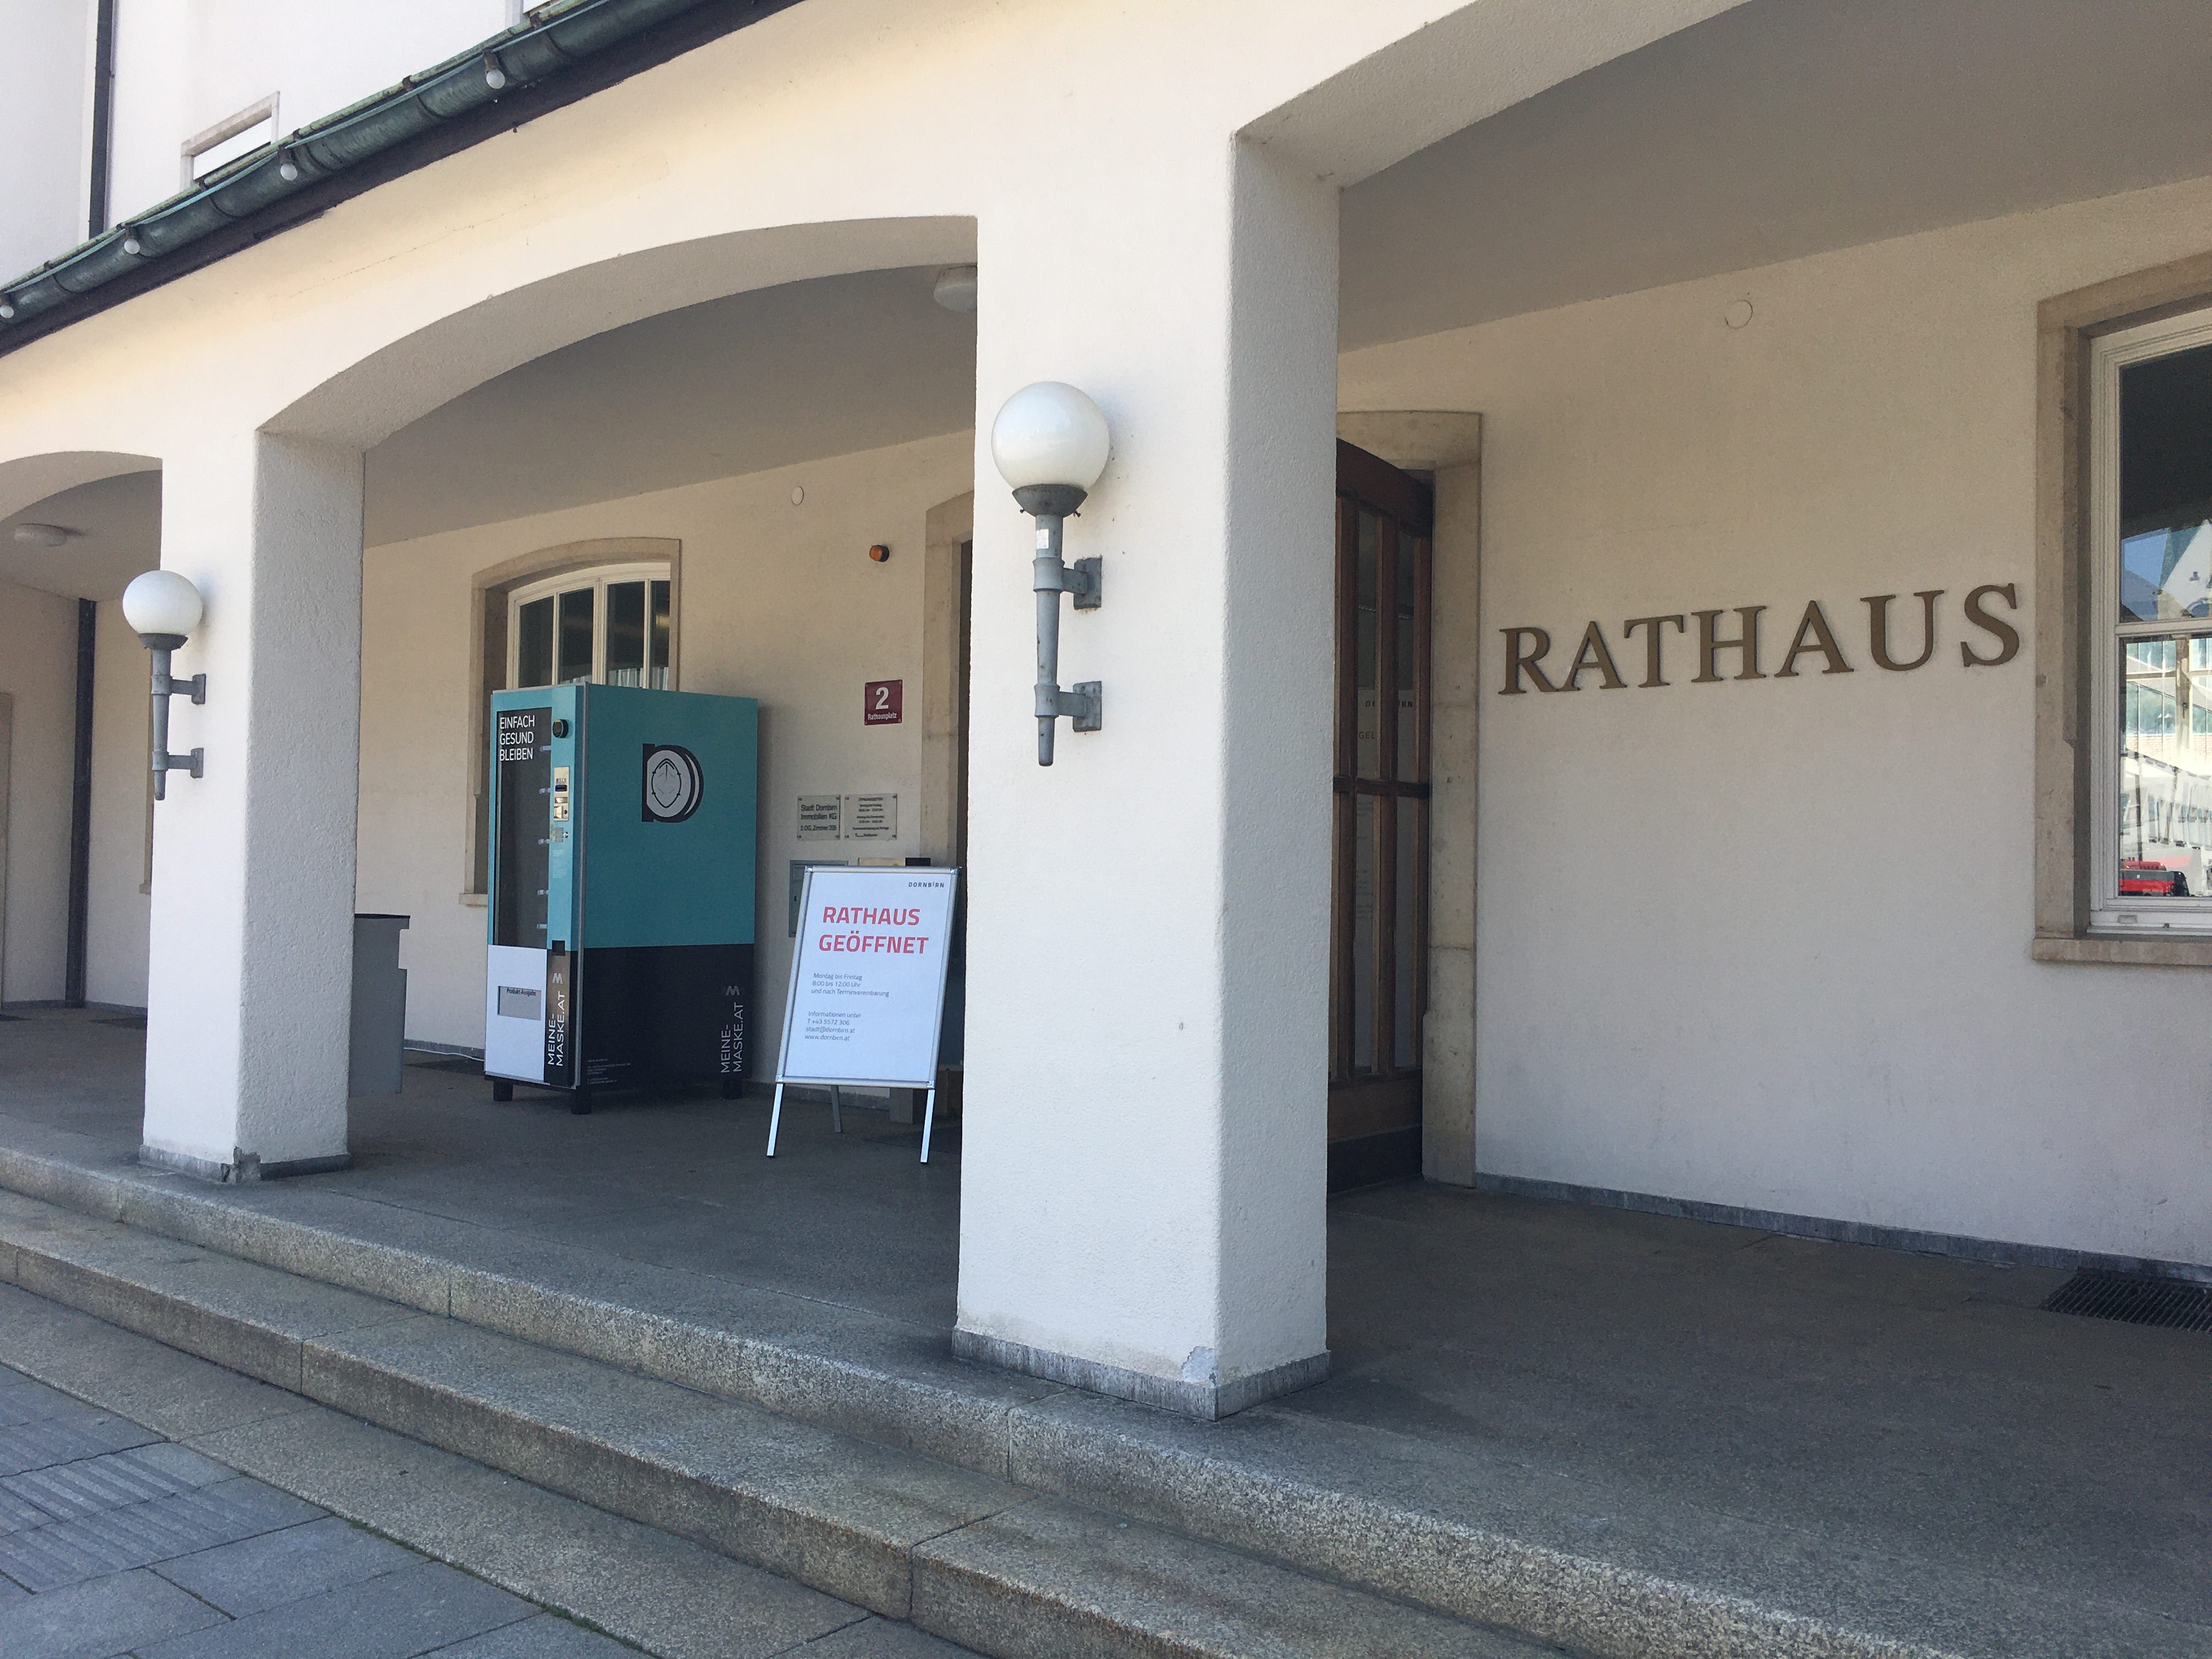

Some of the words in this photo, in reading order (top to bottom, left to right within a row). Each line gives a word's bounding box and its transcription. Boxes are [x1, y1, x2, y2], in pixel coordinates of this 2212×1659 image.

[1498, 583, 2020, 696] RATHAUS
[876, 687, 889, 710] 2
[500, 715, 535, 729] EINFACH
[500, 731, 534, 745] GESUND
[499, 748, 533, 761] BLEIBEN
[823, 906, 921, 926] RATHAUS
[819, 930, 929, 954] GEÖFFNET
[837, 989, 889, 997] Terminvereinbarung
[548, 1014, 556, 1065] MEINE-
[556, 991, 565, 1066] MASKE.AT
[733, 1002, 743, 1072] MASKE.AT
[721, 1024, 731, 1073] MEINE-
